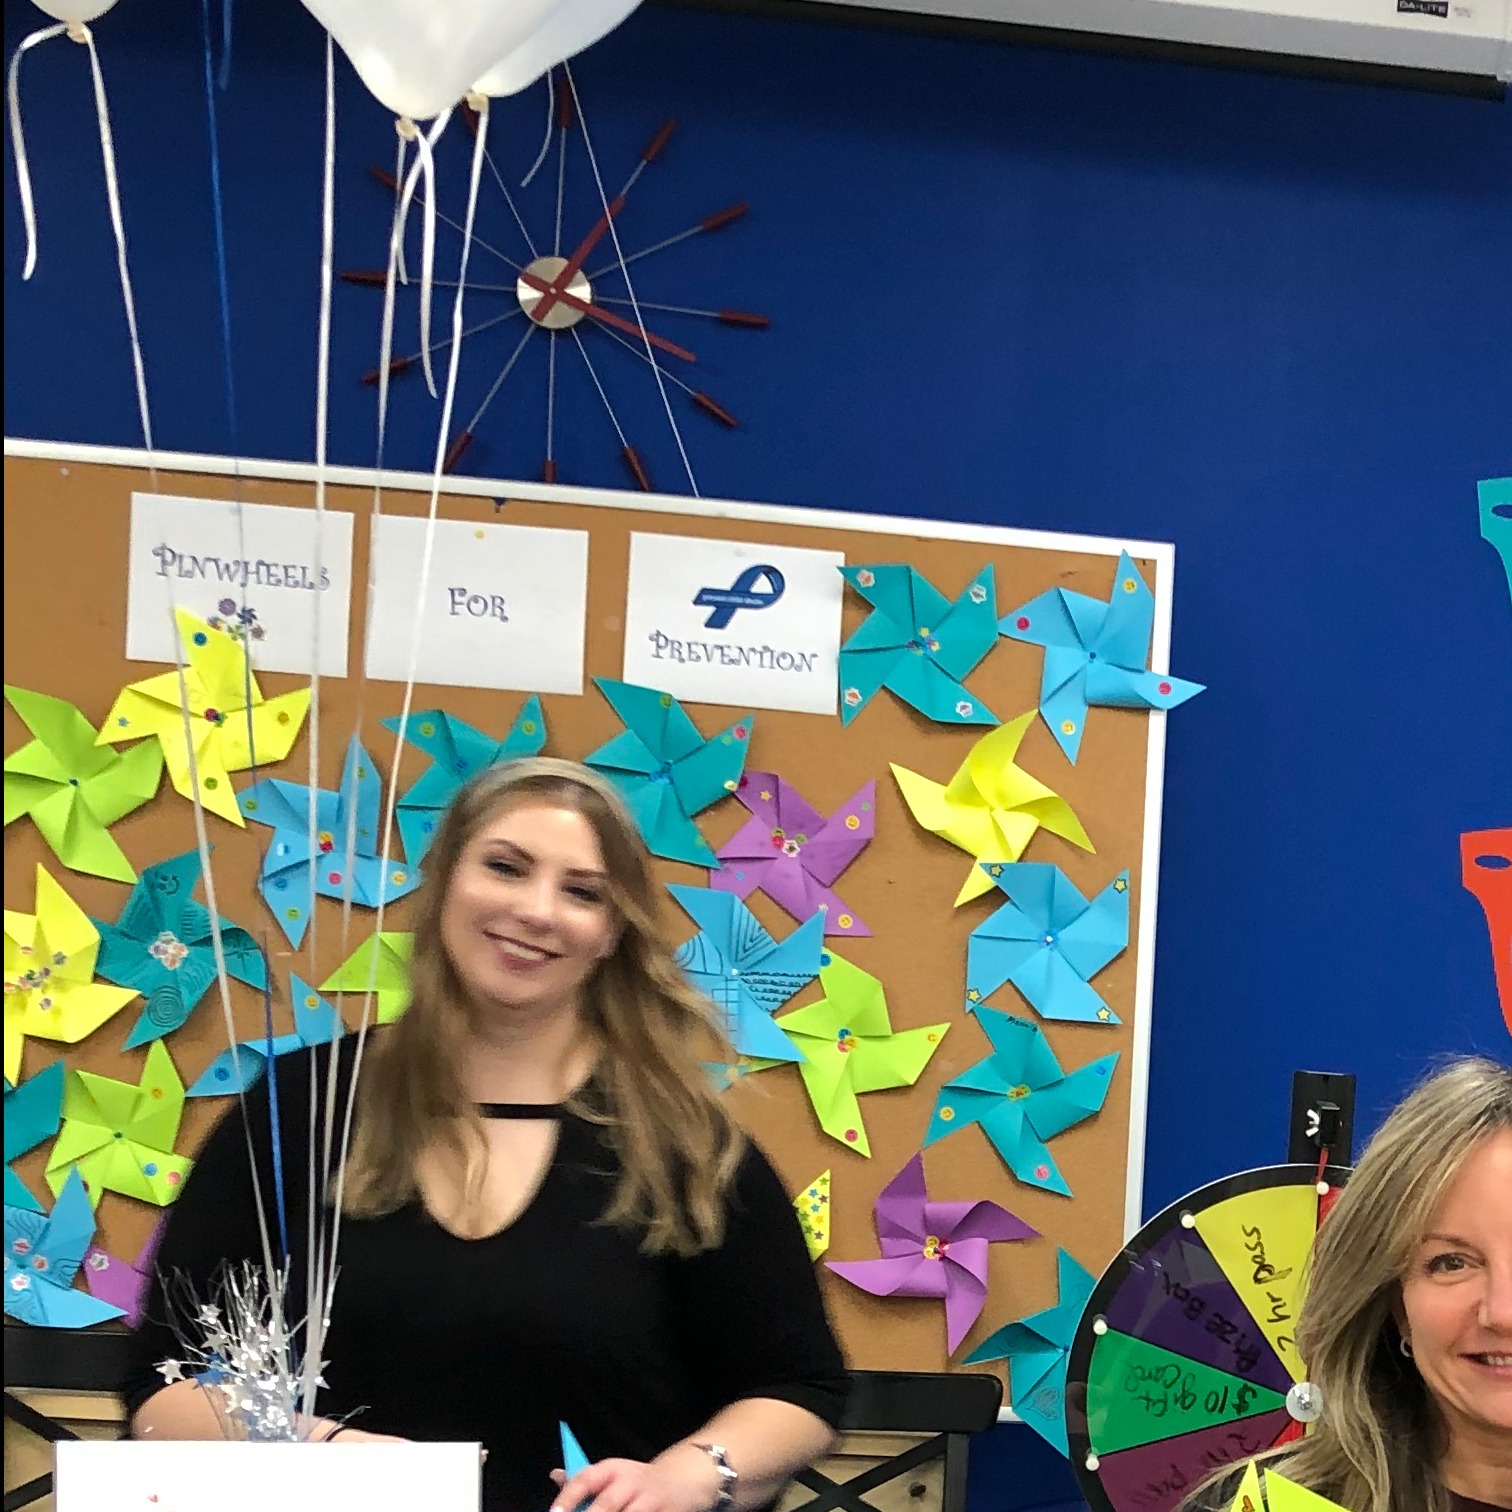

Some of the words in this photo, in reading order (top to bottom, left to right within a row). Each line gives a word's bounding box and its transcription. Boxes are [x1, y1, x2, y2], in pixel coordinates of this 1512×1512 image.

[152, 543, 330, 590] PINWHEELS
[447, 586, 509, 624] FOR
[649, 629, 819, 672] PREVENTION
[1241, 1224, 1293, 1287] pass
